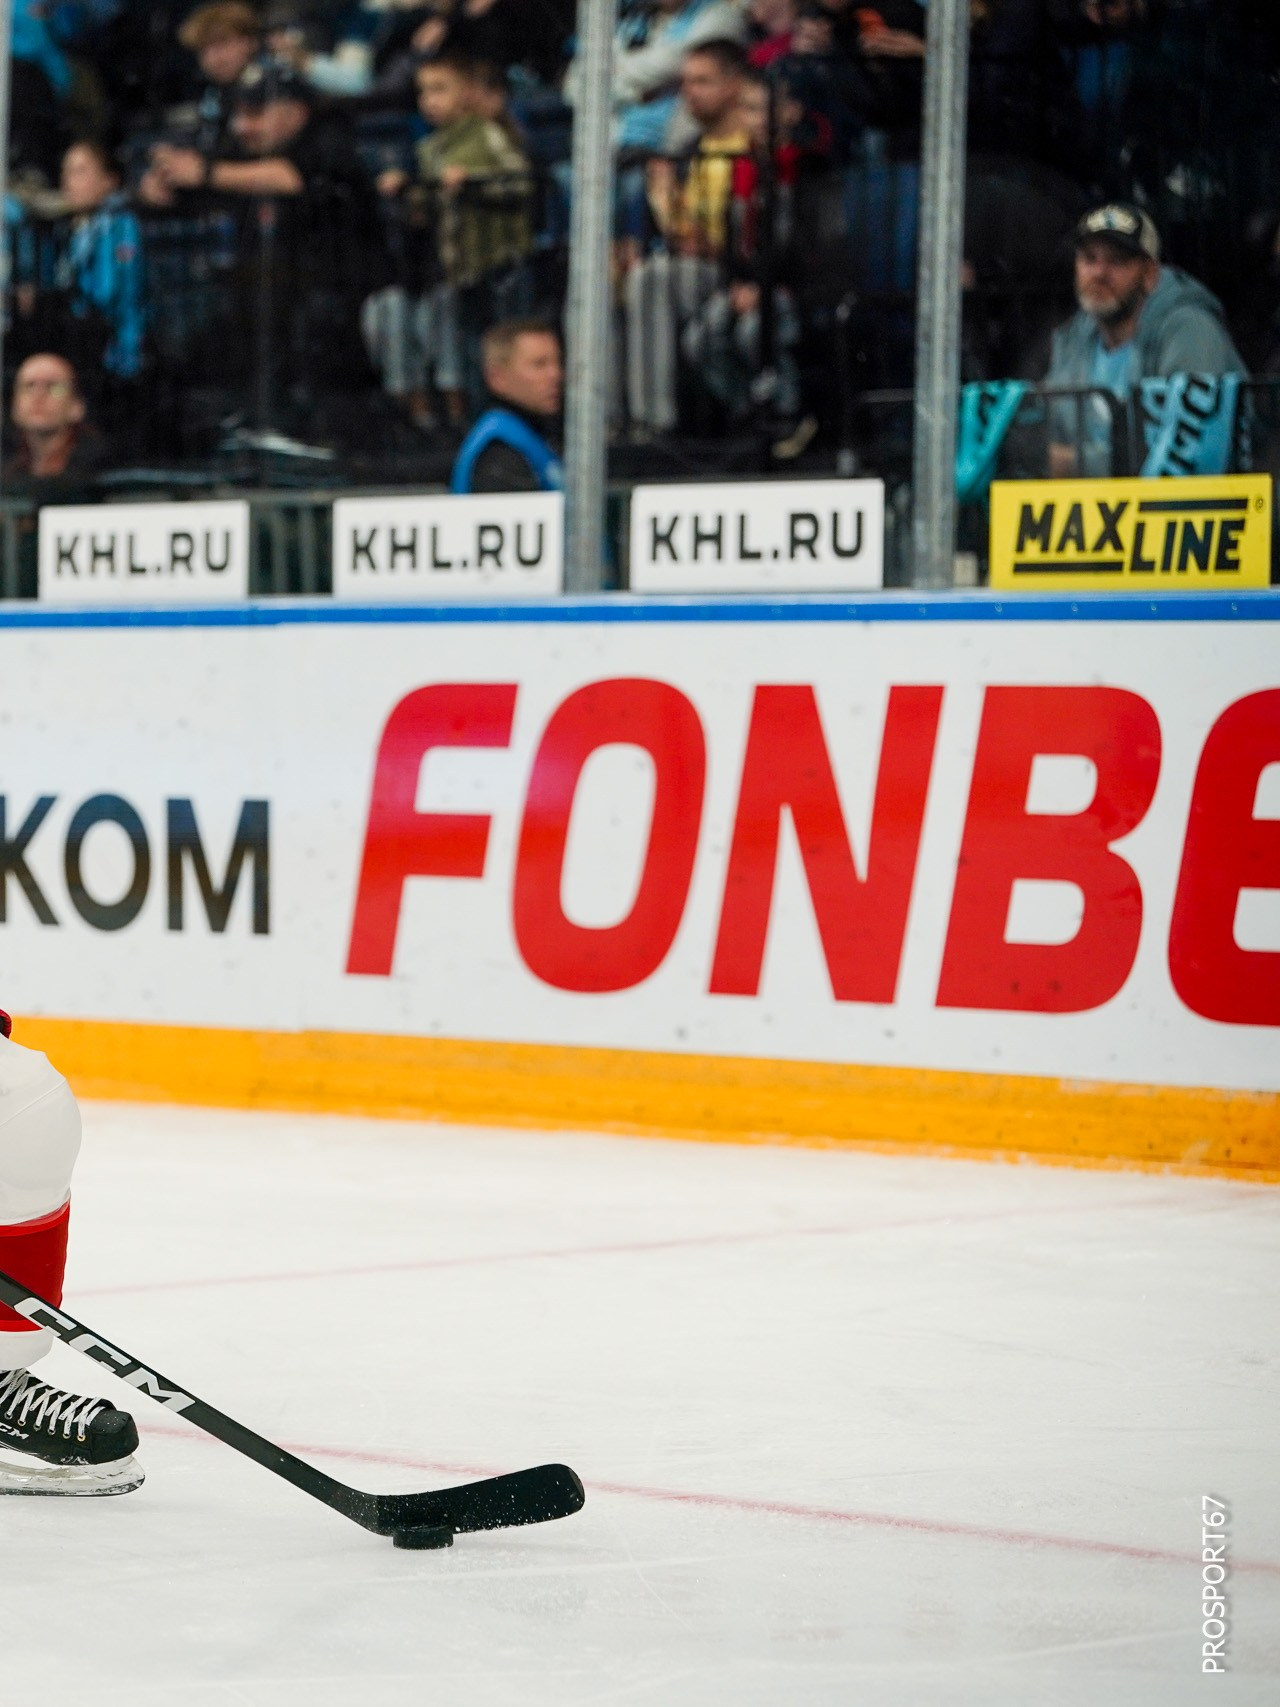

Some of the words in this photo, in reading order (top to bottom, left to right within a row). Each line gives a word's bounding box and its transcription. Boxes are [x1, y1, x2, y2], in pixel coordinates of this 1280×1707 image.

[56, 530, 231, 575] KHL.RU
[352, 522, 545, 571] KHL.RU
[651, 510, 863, 561] KHL.RU
[14, 1297, 195, 1413] CCM
